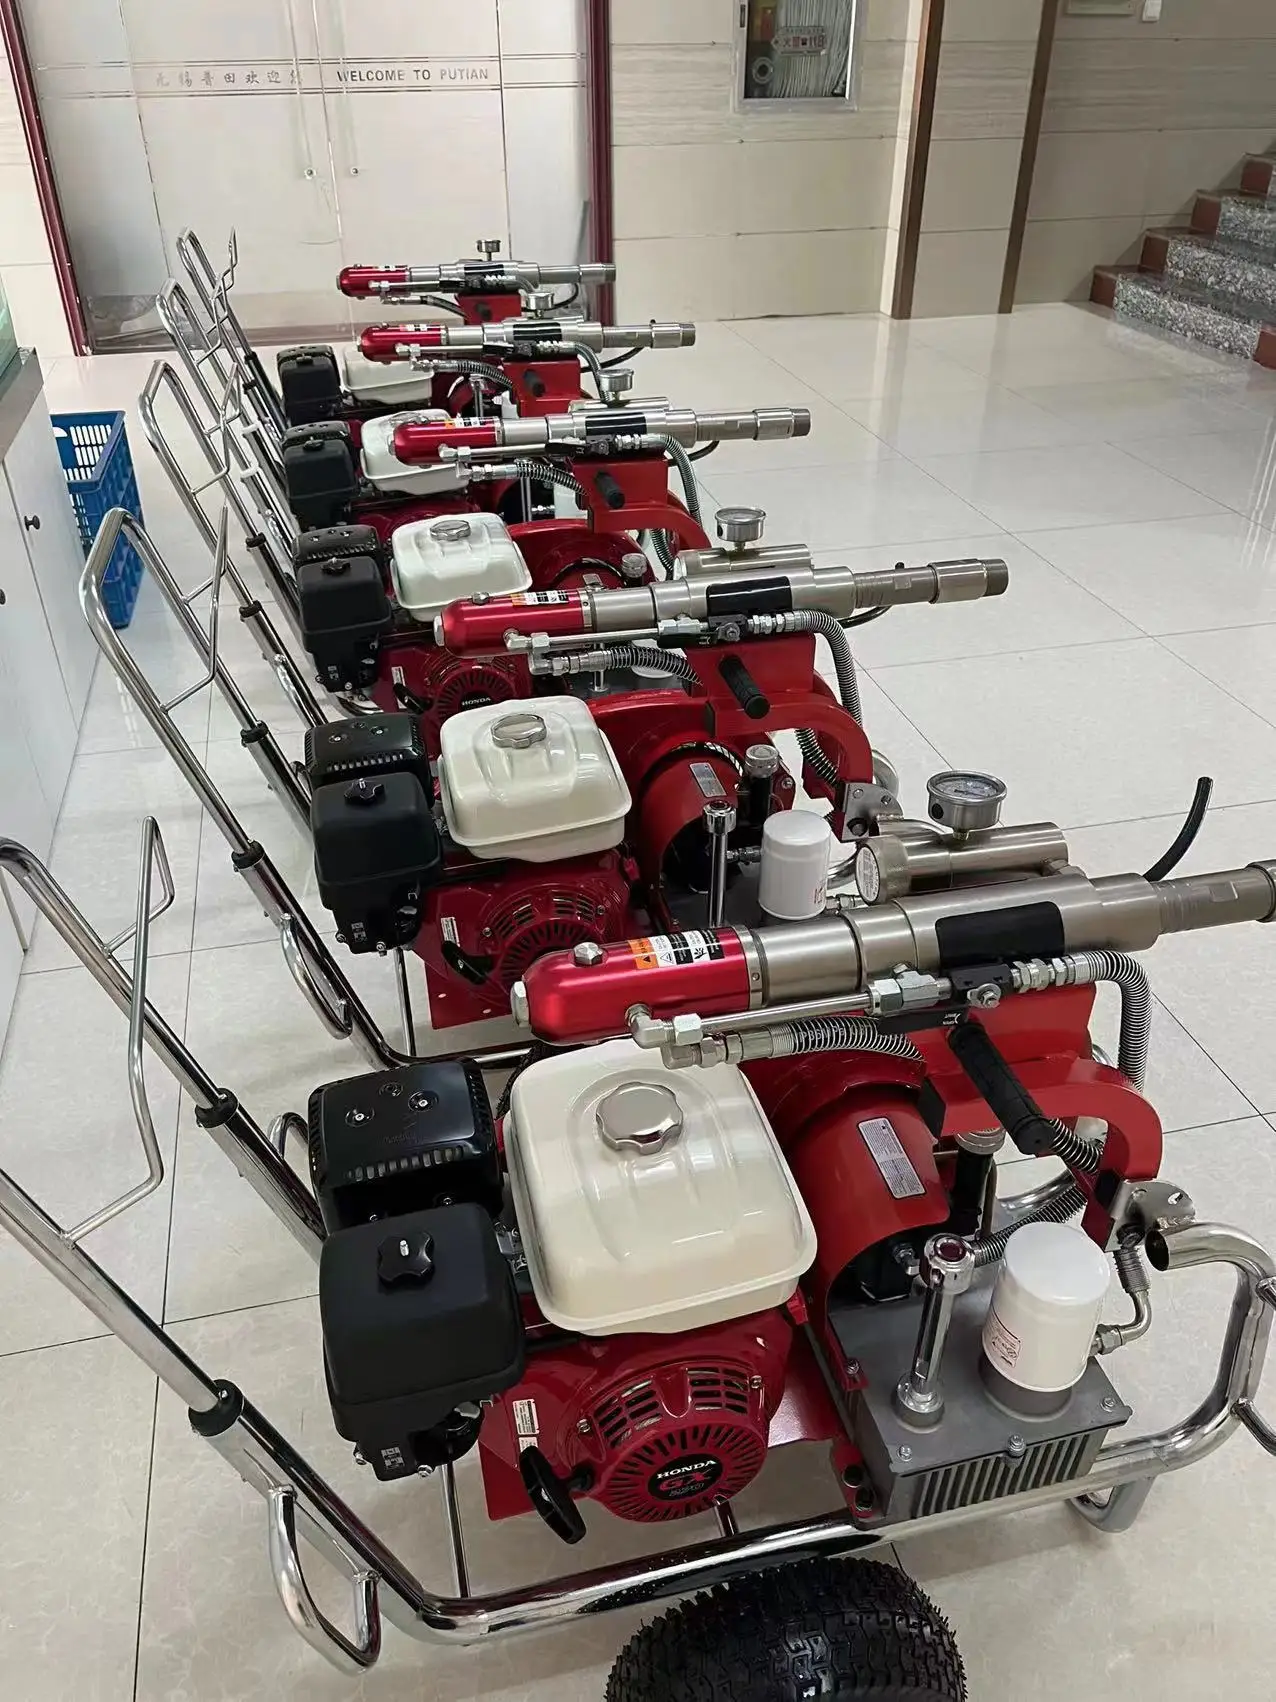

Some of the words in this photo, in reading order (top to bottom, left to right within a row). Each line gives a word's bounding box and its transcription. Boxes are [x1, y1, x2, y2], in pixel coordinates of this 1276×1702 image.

[336, 70, 405, 82] WELCOME
[413, 69, 431, 81] TO
[440, 68, 489, 80] PUTIAN
[462, 697, 491, 705] HONDA
[657, 1460, 717, 1479] HONDA
